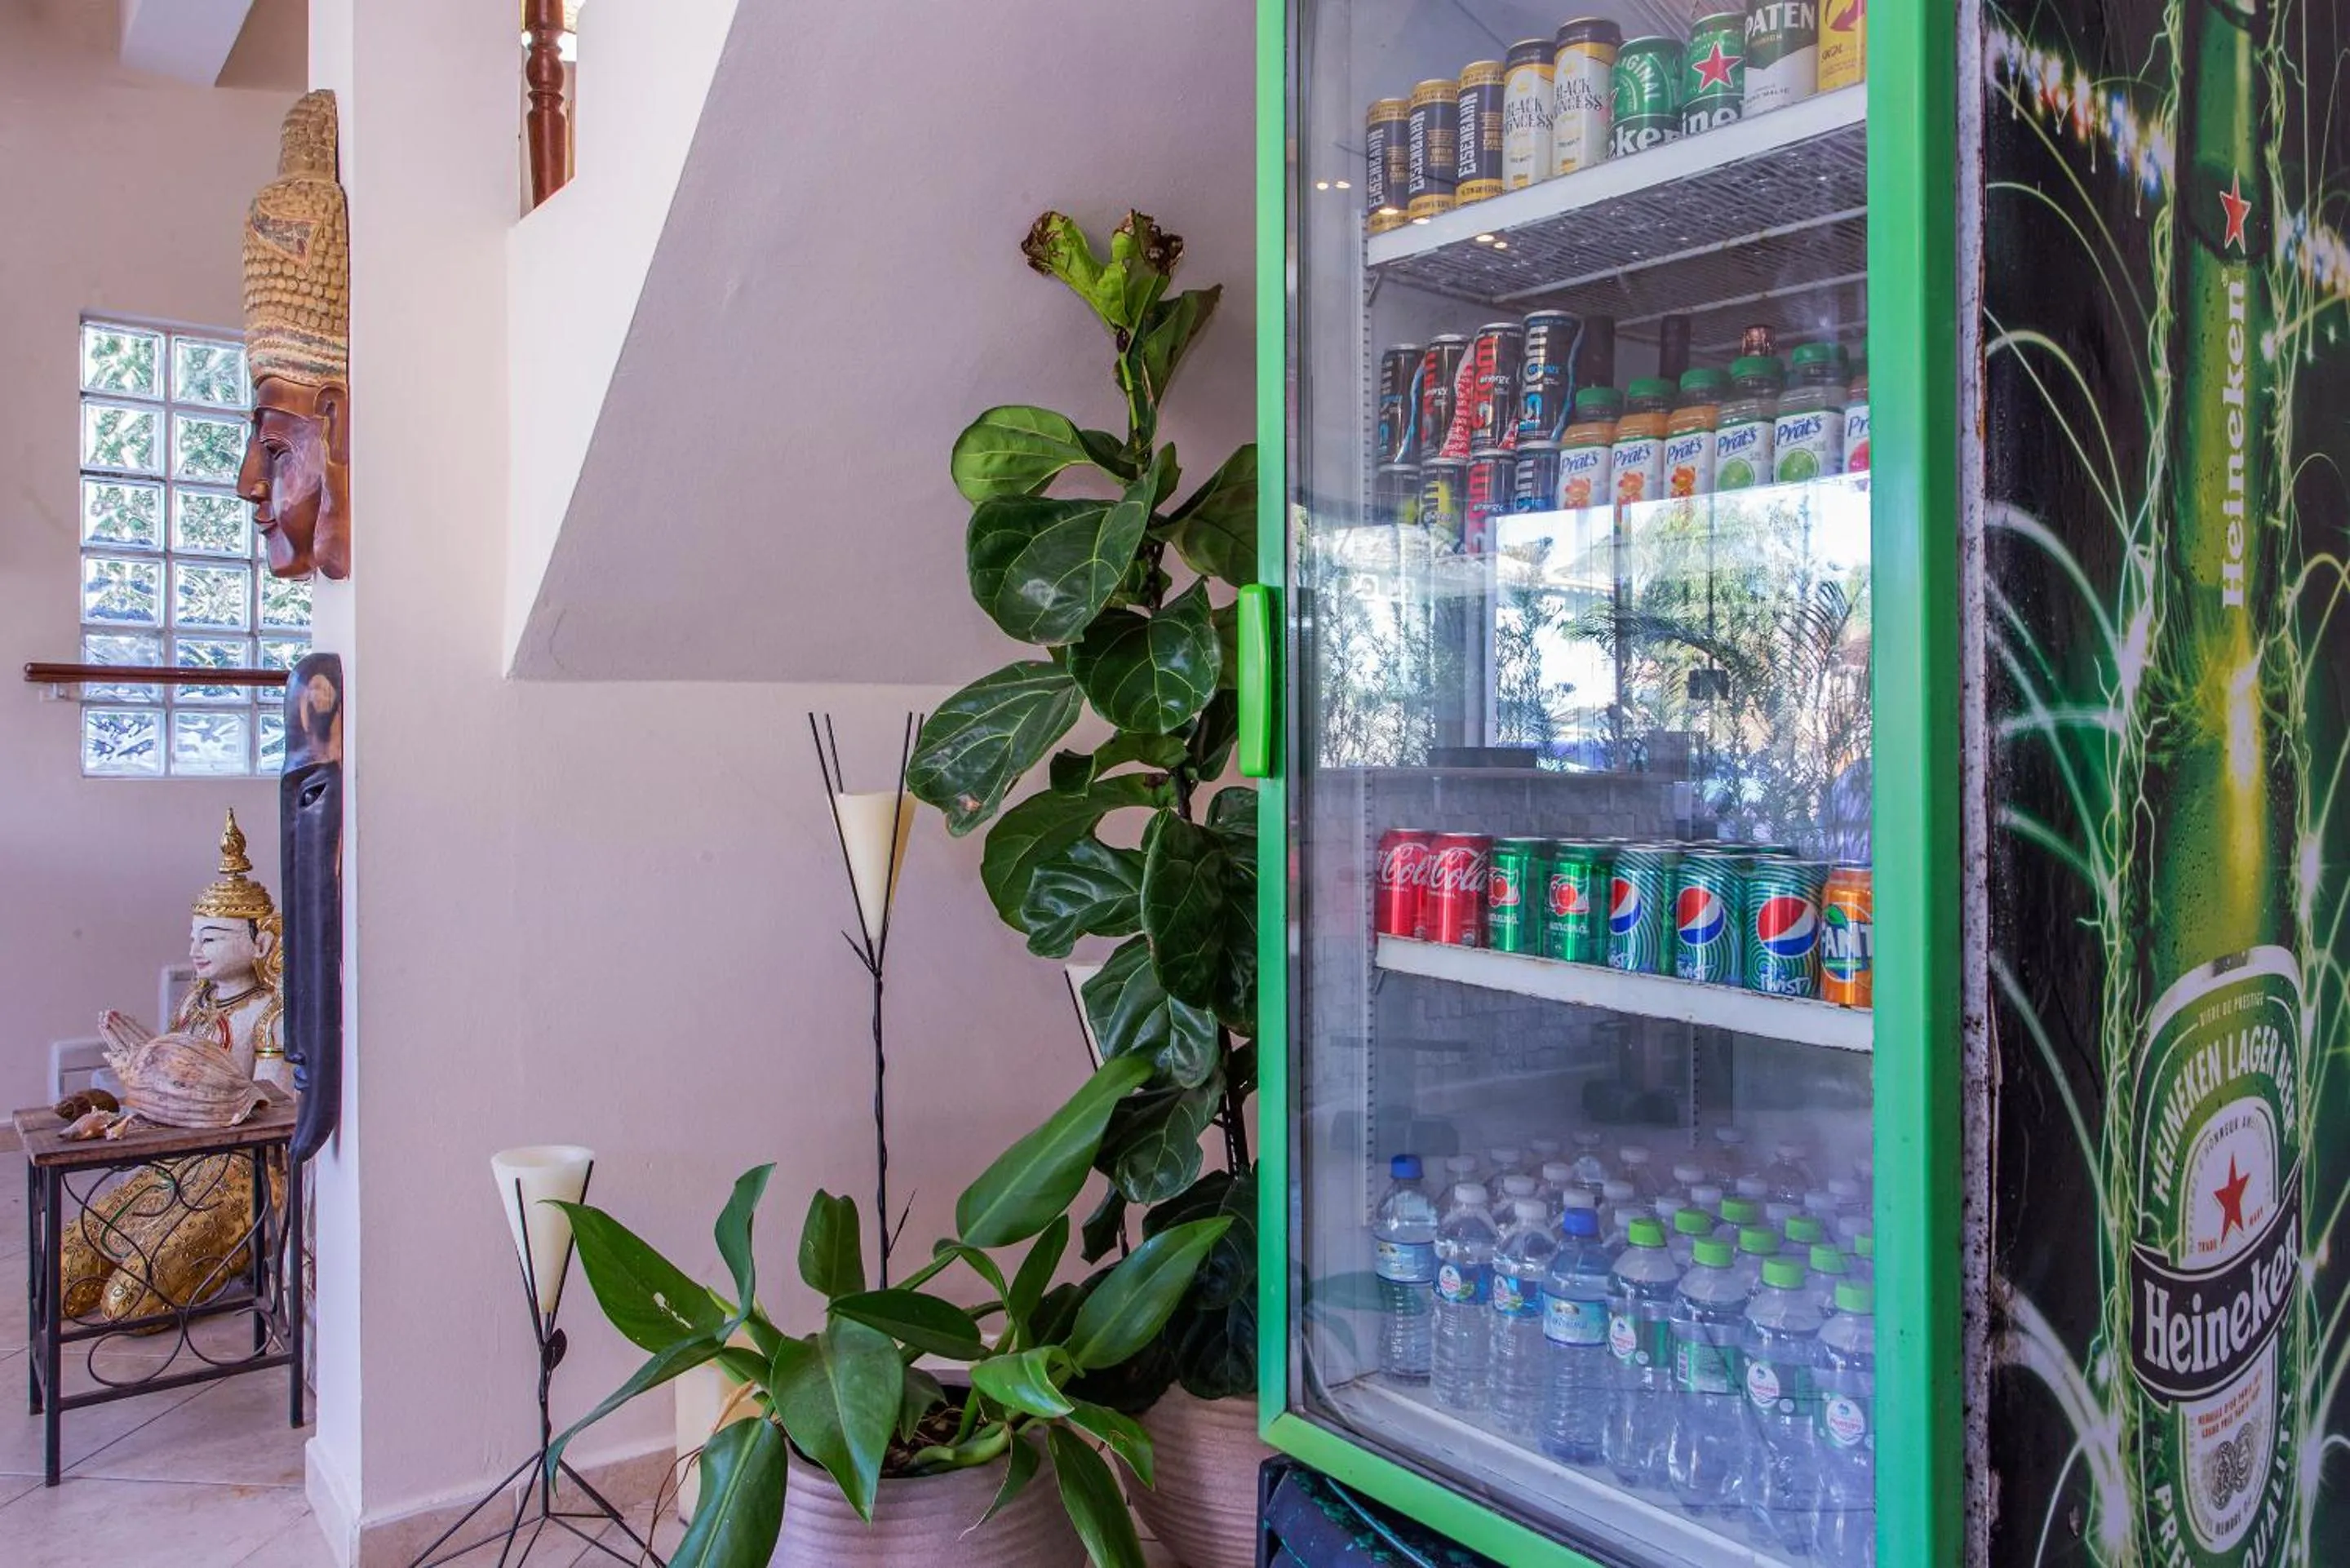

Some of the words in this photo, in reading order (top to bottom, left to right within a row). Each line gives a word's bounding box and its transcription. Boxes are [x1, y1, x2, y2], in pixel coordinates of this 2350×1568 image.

[1745, 2, 1815, 44] PATEN
[1622, 52, 1661, 100] IGINAL
[1408, 110, 1426, 194] EISENBAHN
[1458, 92, 1478, 178] EISENBAHN
[1368, 128, 1385, 207] EISENBAHN
[1666, 436, 1703, 463] Prat's
[1717, 426, 1758, 457] Prat's
[1776, 415, 1822, 446] Prat's
[2222, 280, 2245, 609] Heineken
[1560, 450, 1599, 474] Prat's
[1612, 443, 1652, 468] Prat's
[2152, 1039, 2222, 1207] HEINEKEN
[2228, 1024, 2279, 1081] LAGER
[2143, 1213, 2299, 1375] Heineken
